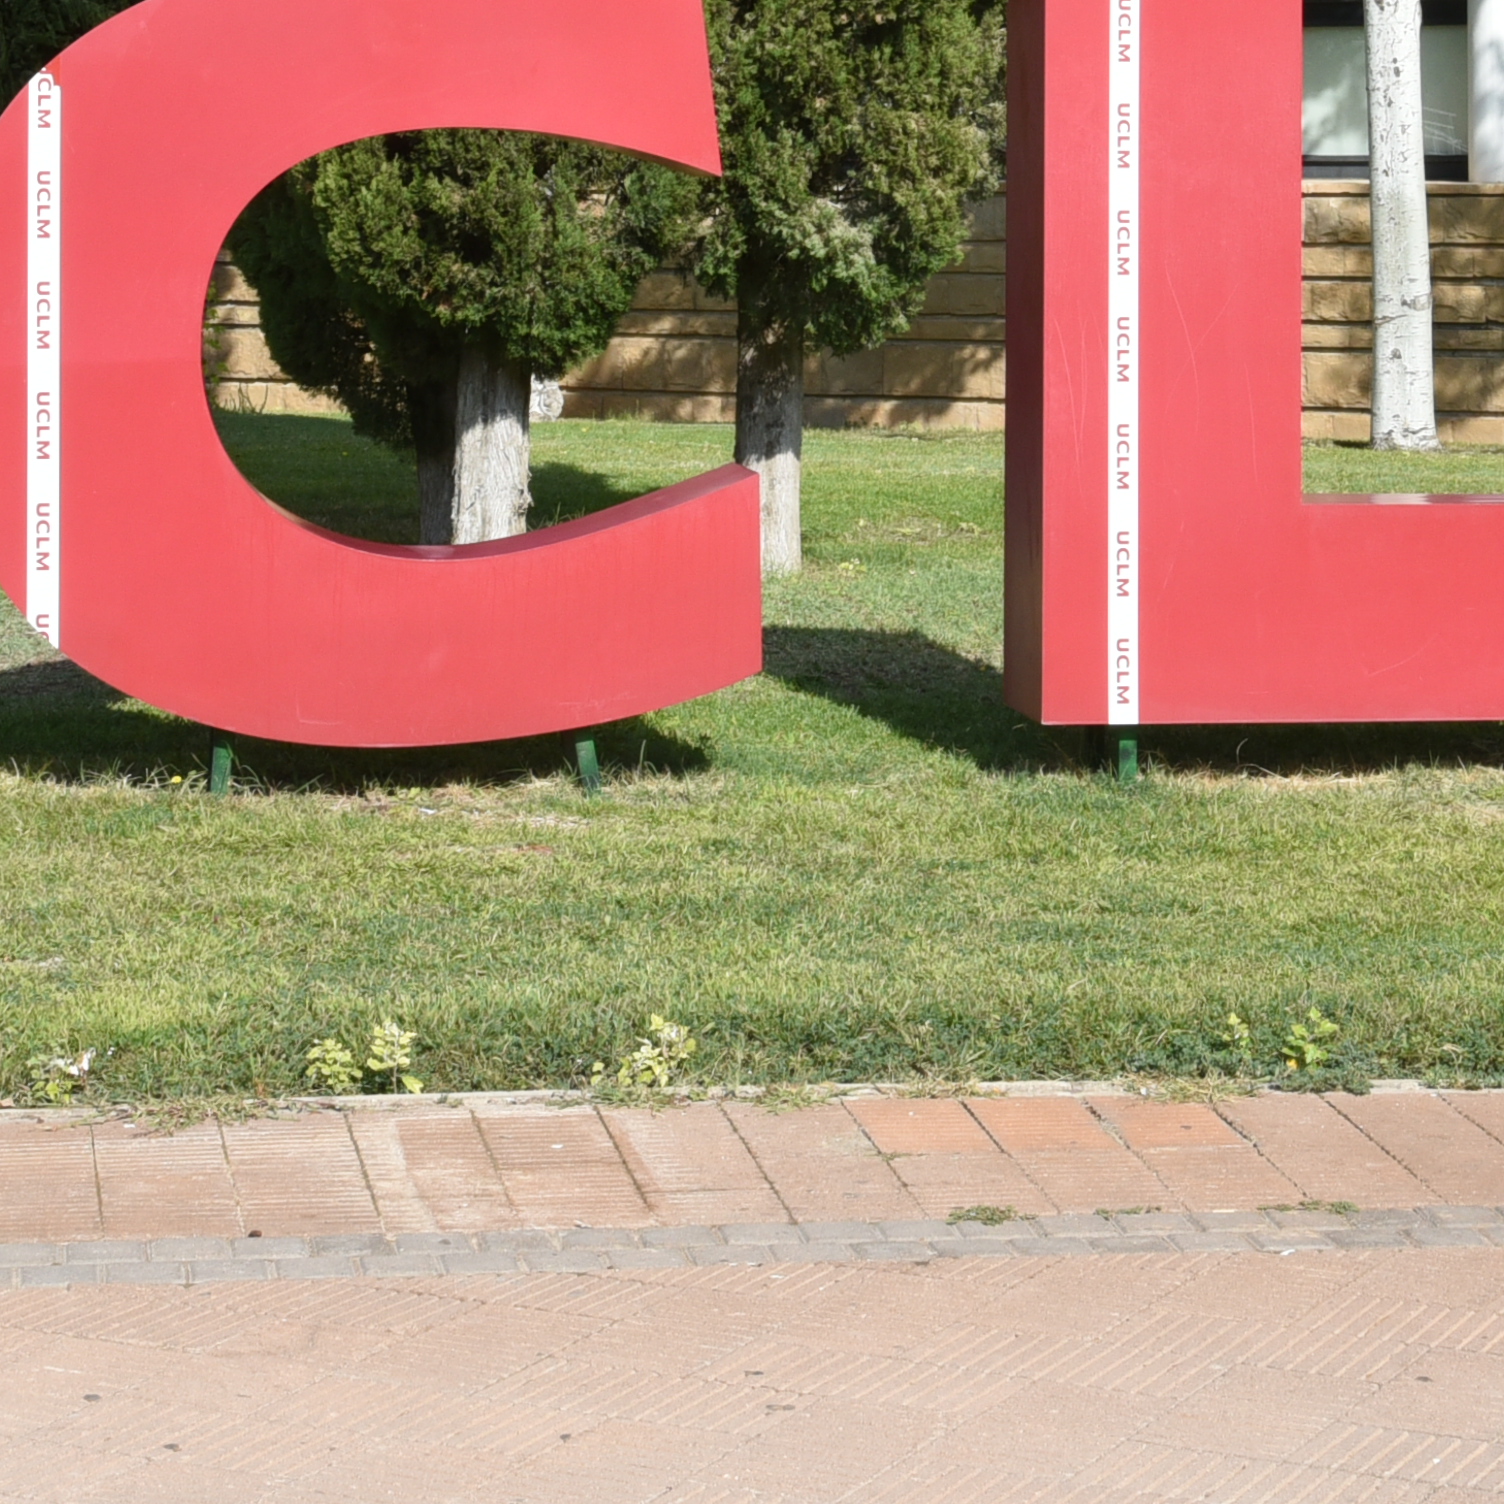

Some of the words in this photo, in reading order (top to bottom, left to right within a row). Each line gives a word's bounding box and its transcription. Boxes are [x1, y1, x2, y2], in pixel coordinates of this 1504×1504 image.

[1117, 103, 1132, 169] UCLM
[36, 170, 52, 239] UCLM
[1116, 210, 1131, 276] UCLM
[36, 281, 52, 350] UCLM
[1116, 316, 1131, 382] UCLM
[36, 391, 52, 460] UCLM
[1116, 423, 1131, 490] UCLM
[36, 502, 51, 571] UCLM
[1116, 531, 1131, 597] UCLM
[1116, 638, 1131, 705] UCLM
